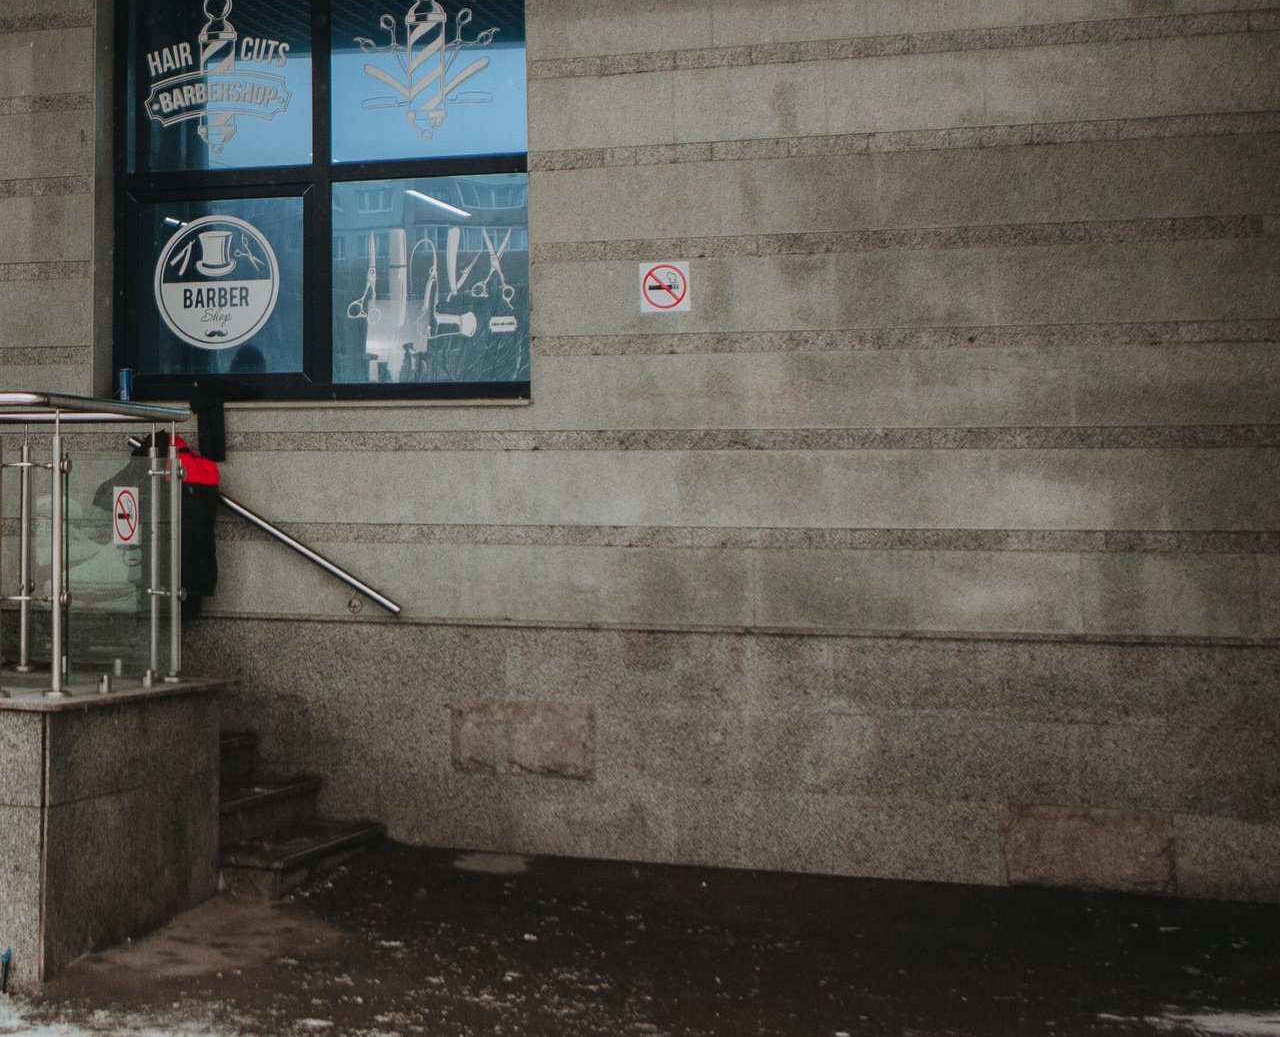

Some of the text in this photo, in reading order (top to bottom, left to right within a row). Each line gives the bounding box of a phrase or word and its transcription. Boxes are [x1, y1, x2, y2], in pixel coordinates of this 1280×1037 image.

[146, 36, 290, 77] HAIR CUTS
[158, 81, 279, 114] BARBERSHOP
[183, 286, 250, 309] BARBER
[200, 307, 233, 328] Shop
